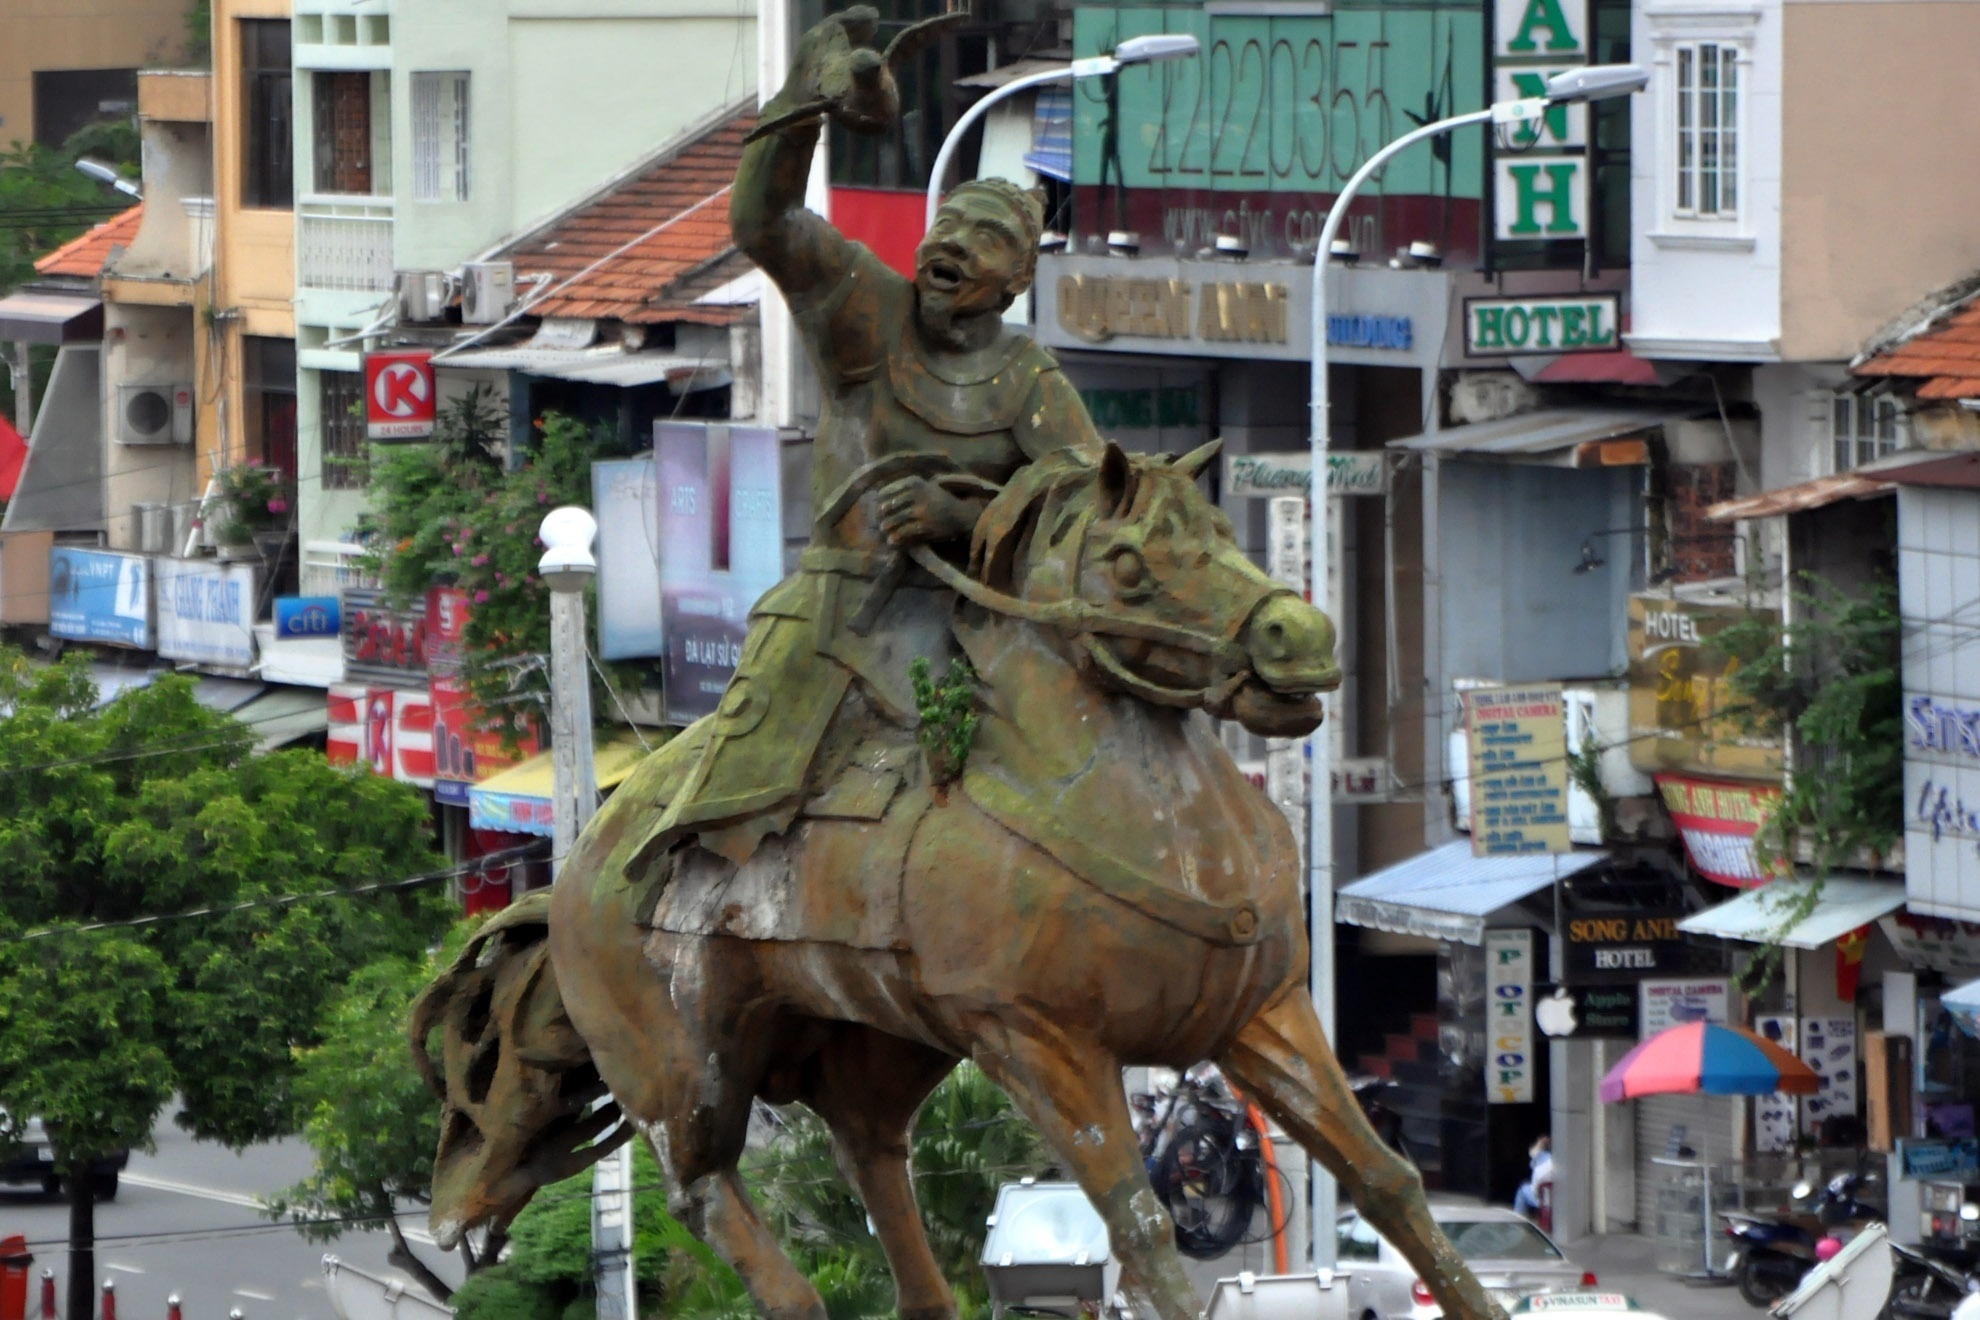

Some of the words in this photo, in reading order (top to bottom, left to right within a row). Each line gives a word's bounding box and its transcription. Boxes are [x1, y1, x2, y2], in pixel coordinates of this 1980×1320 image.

[1056, 272, 1191, 344] QUEEN
[1327, 313, 1413, 350] UILDING
[1474, 304, 1614, 348] HOTEL
[671, 486, 696, 515] ARTS
[287, 608, 328, 634] citi
[1645, 611, 1704, 642] HOTEL
[1516, 703, 1558, 717] CAMERA
[1569, 918, 1628, 942] SONG
[1633, 917, 1680, 940] ANH
[1595, 948, 1656, 969] HOTEL
[1549, 1295, 1597, 1306] VINASUN
